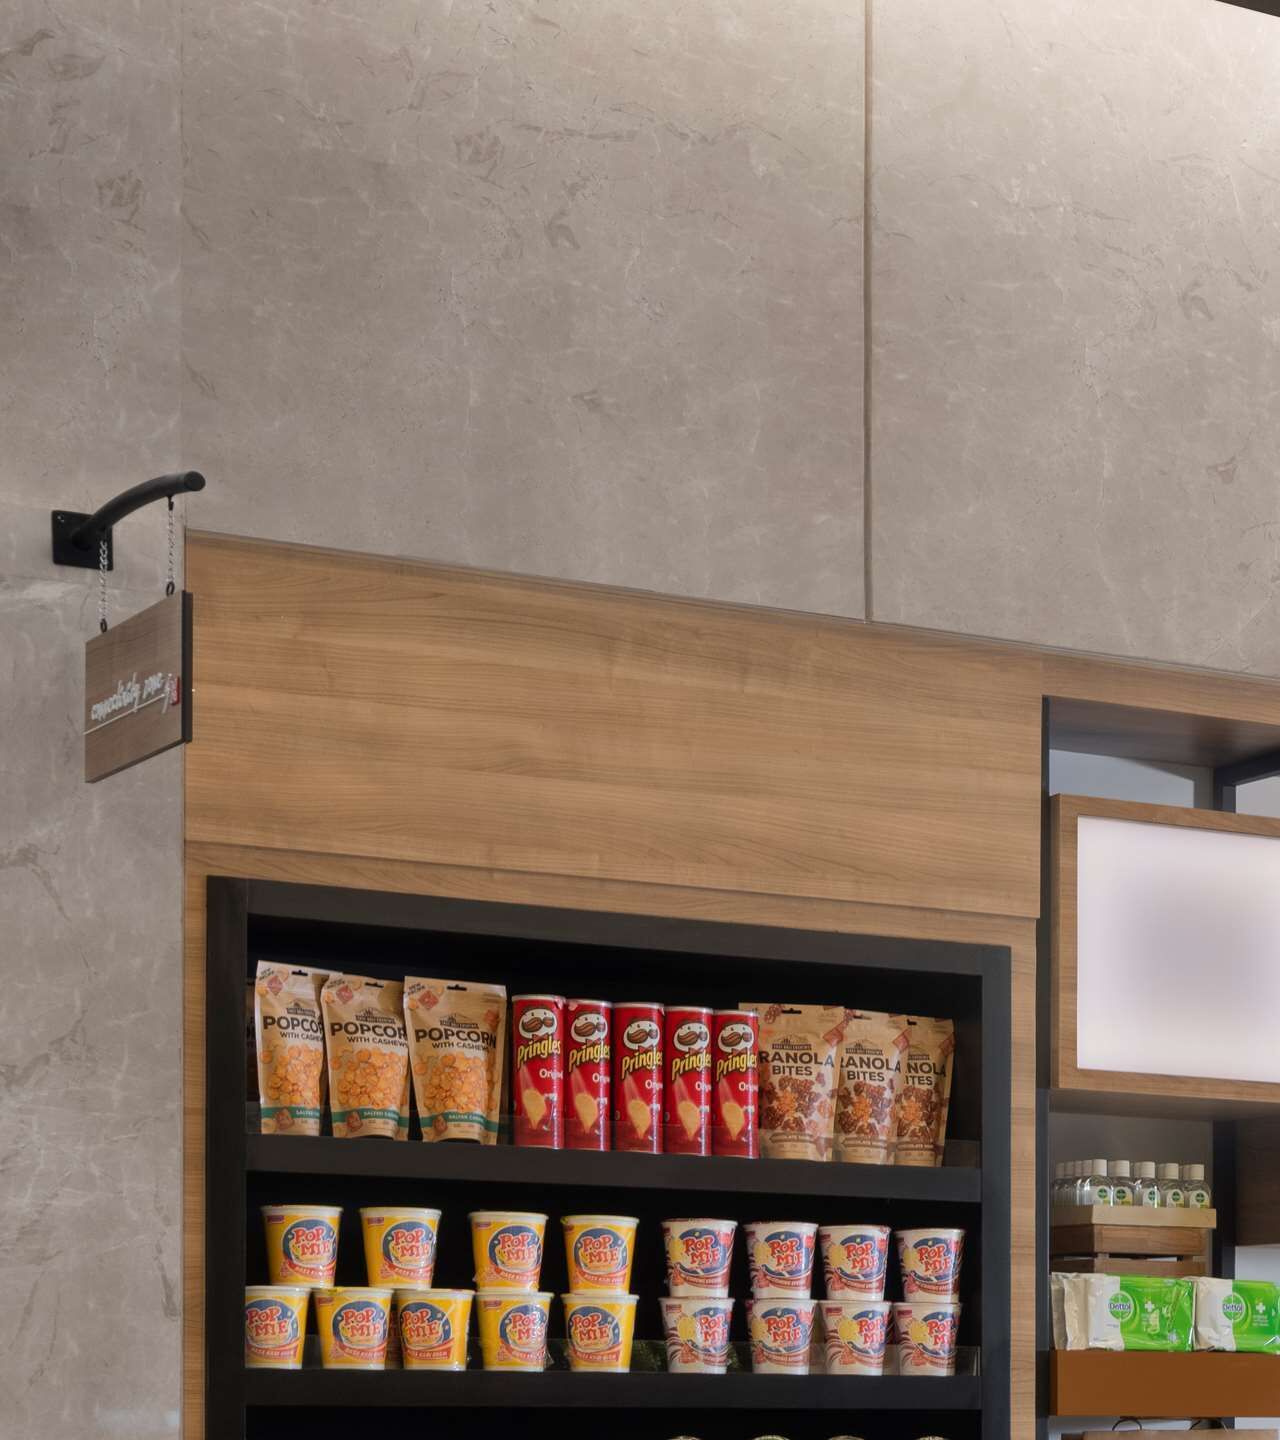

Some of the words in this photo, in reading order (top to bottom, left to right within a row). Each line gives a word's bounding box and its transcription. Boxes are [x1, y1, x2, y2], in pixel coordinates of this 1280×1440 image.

[280, 1031, 300, 1040] WITH
[330, 1021, 405, 1041] POPCOR
[416, 1027, 497, 1049] POPCORN
[347, 1036, 371, 1044] WITH
[431, 1041, 454, 1049] WITH
[517, 1038, 561, 1069] Pringles
[568, 1042, 610, 1073] Pringles
[760, 1050, 834, 1068] RANOLA
[772, 1065, 813, 1076] BITES
[840, 1057, 900, 1074] ANOLA
[907, 1061, 946, 1077] NOLA
[847, 1071, 885, 1082] BITES
[905, 1075, 933, 1086] ITES
[293, 1226, 325, 1245] POP
[393, 1228, 425, 1246] POP
[499, 1232, 533, 1250] POP
[580, 1235, 612, 1252] POP
[683, 1236, 714, 1256] POP
[769, 1238, 799, 1255] POP
[844, 1241, 872, 1258] POP
[917, 1244, 944, 1261] POP
[1108, 1301, 1131, 1312] Dettol
[1222, 1301, 1243, 1312] Dettol
[247, 1306, 281, 1325] POP
[343, 1308, 376, 1325] POP
[402, 1309, 431, 1327] POP
[571, 1312, 601, 1331] POP
[767, 1317, 796, 1334] POP
[857, 1318, 882, 1334] POP
